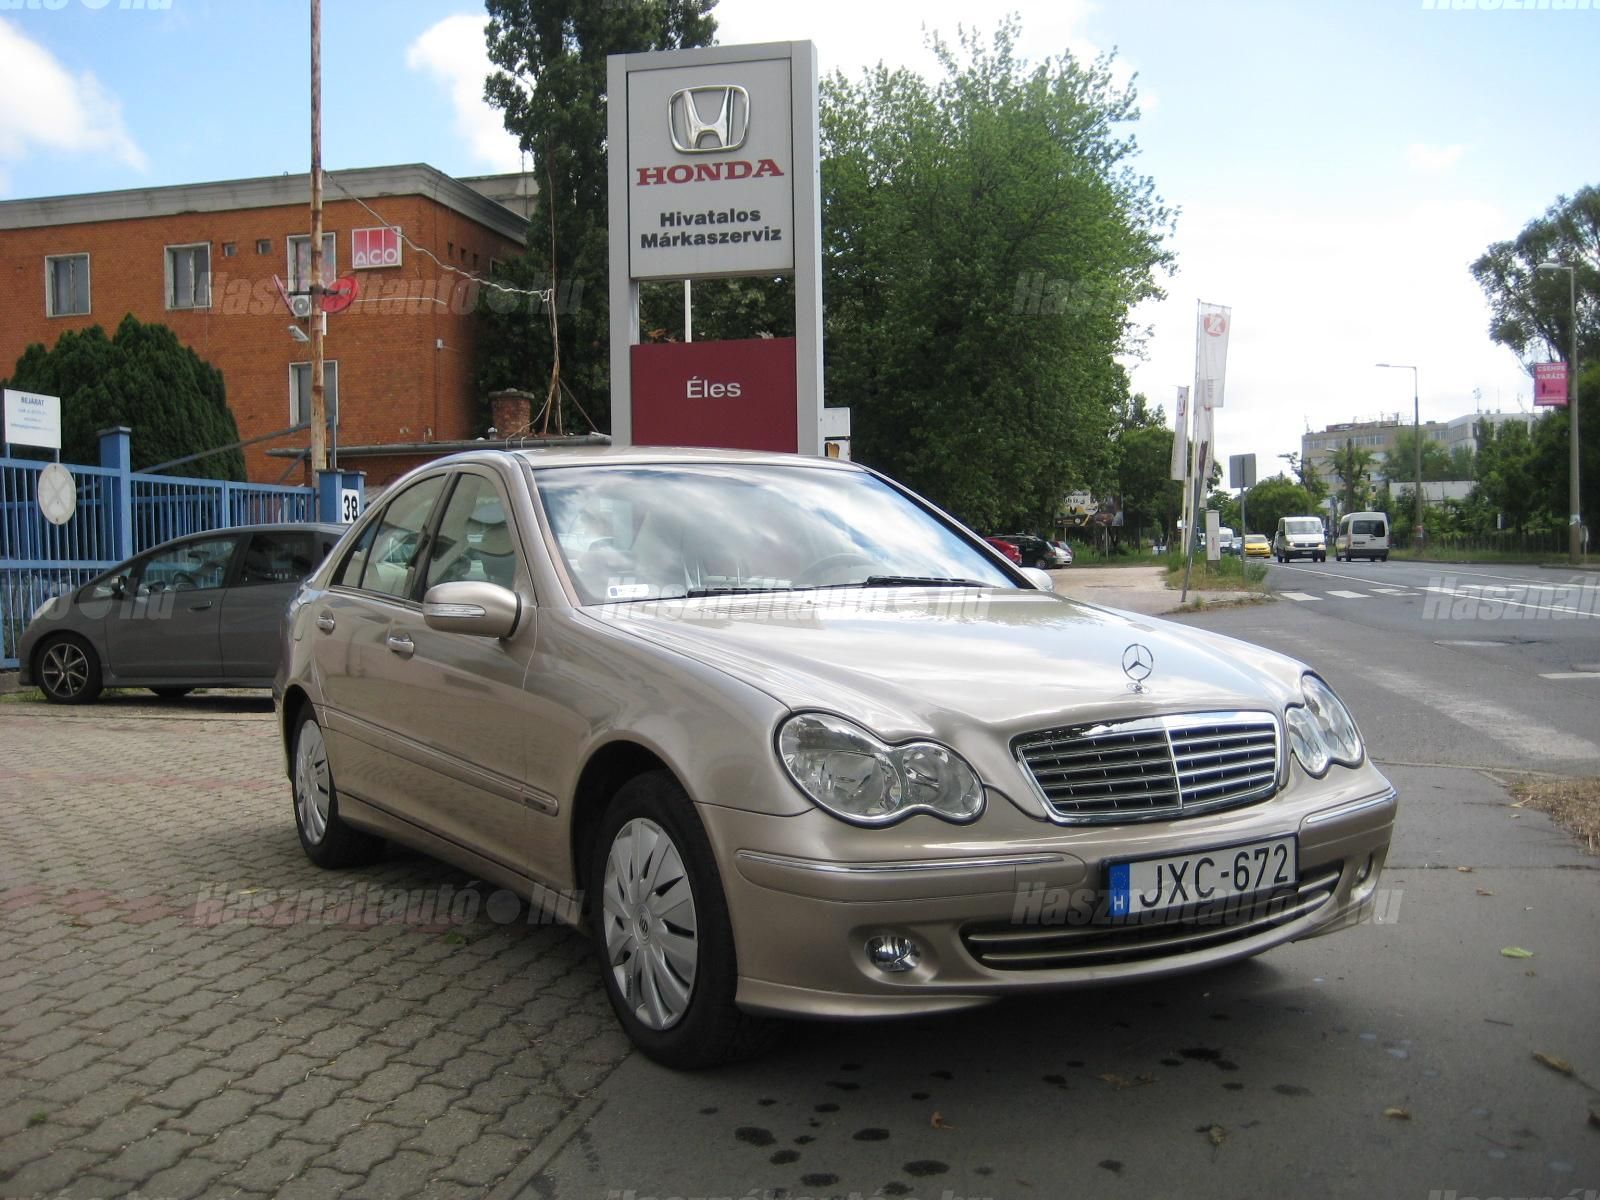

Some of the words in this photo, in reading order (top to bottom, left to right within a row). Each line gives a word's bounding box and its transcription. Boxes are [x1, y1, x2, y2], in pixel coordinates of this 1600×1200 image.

[636, 159, 784, 186] HONDA
[660, 208, 761, 227] Hivatalos
[640, 226, 781, 248] Márkaszerviz
[355, 248, 397, 265] ACO
[687, 376, 741, 398] Éles
[343, 495, 358, 521] 38
[1113, 895, 1123, 911] H
[1139, 843, 1288, 907] JXC-672
